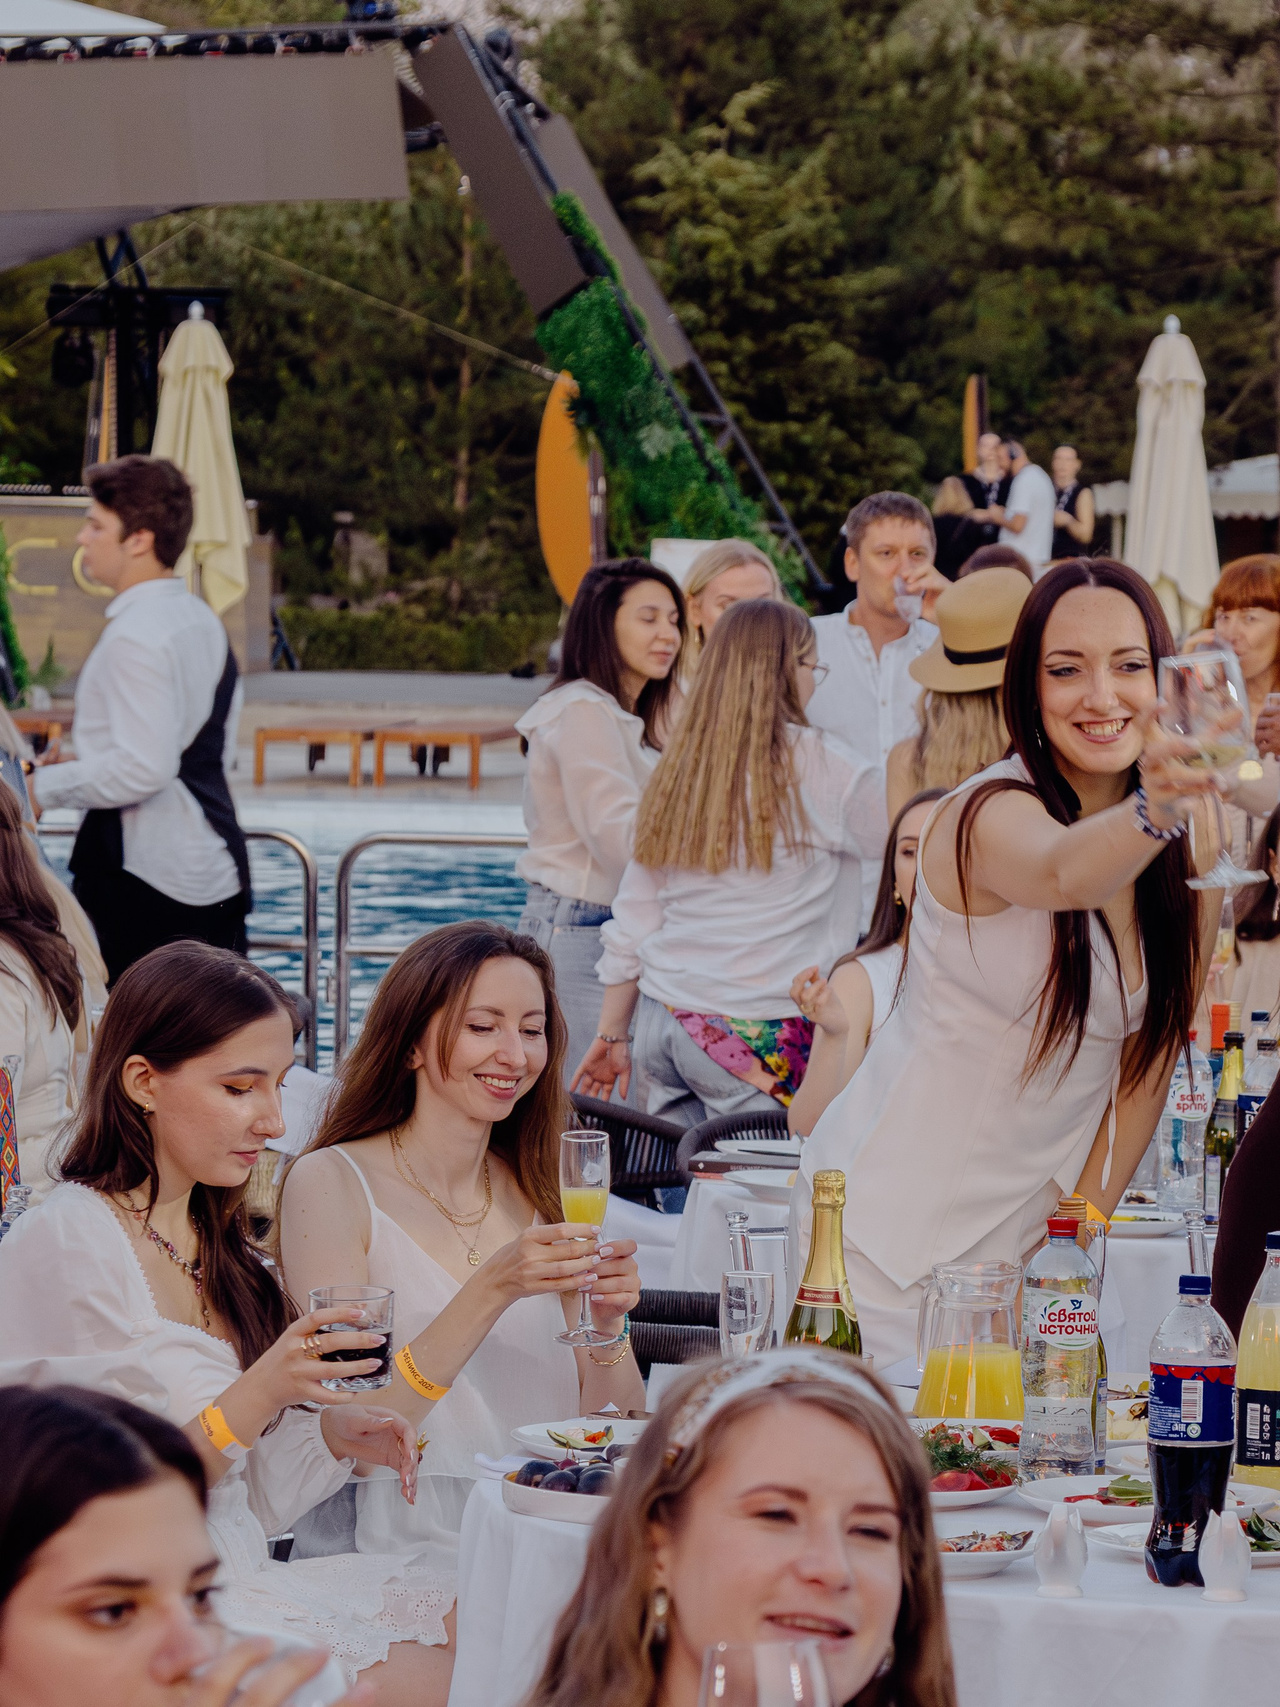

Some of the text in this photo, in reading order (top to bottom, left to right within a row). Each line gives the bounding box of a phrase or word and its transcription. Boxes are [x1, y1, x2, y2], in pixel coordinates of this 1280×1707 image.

[1180, 1093, 1206, 1102] saint
[1176, 1102, 1208, 1113] spring
[403, 1352, 435, 1391] ФЕНИКС 2025
